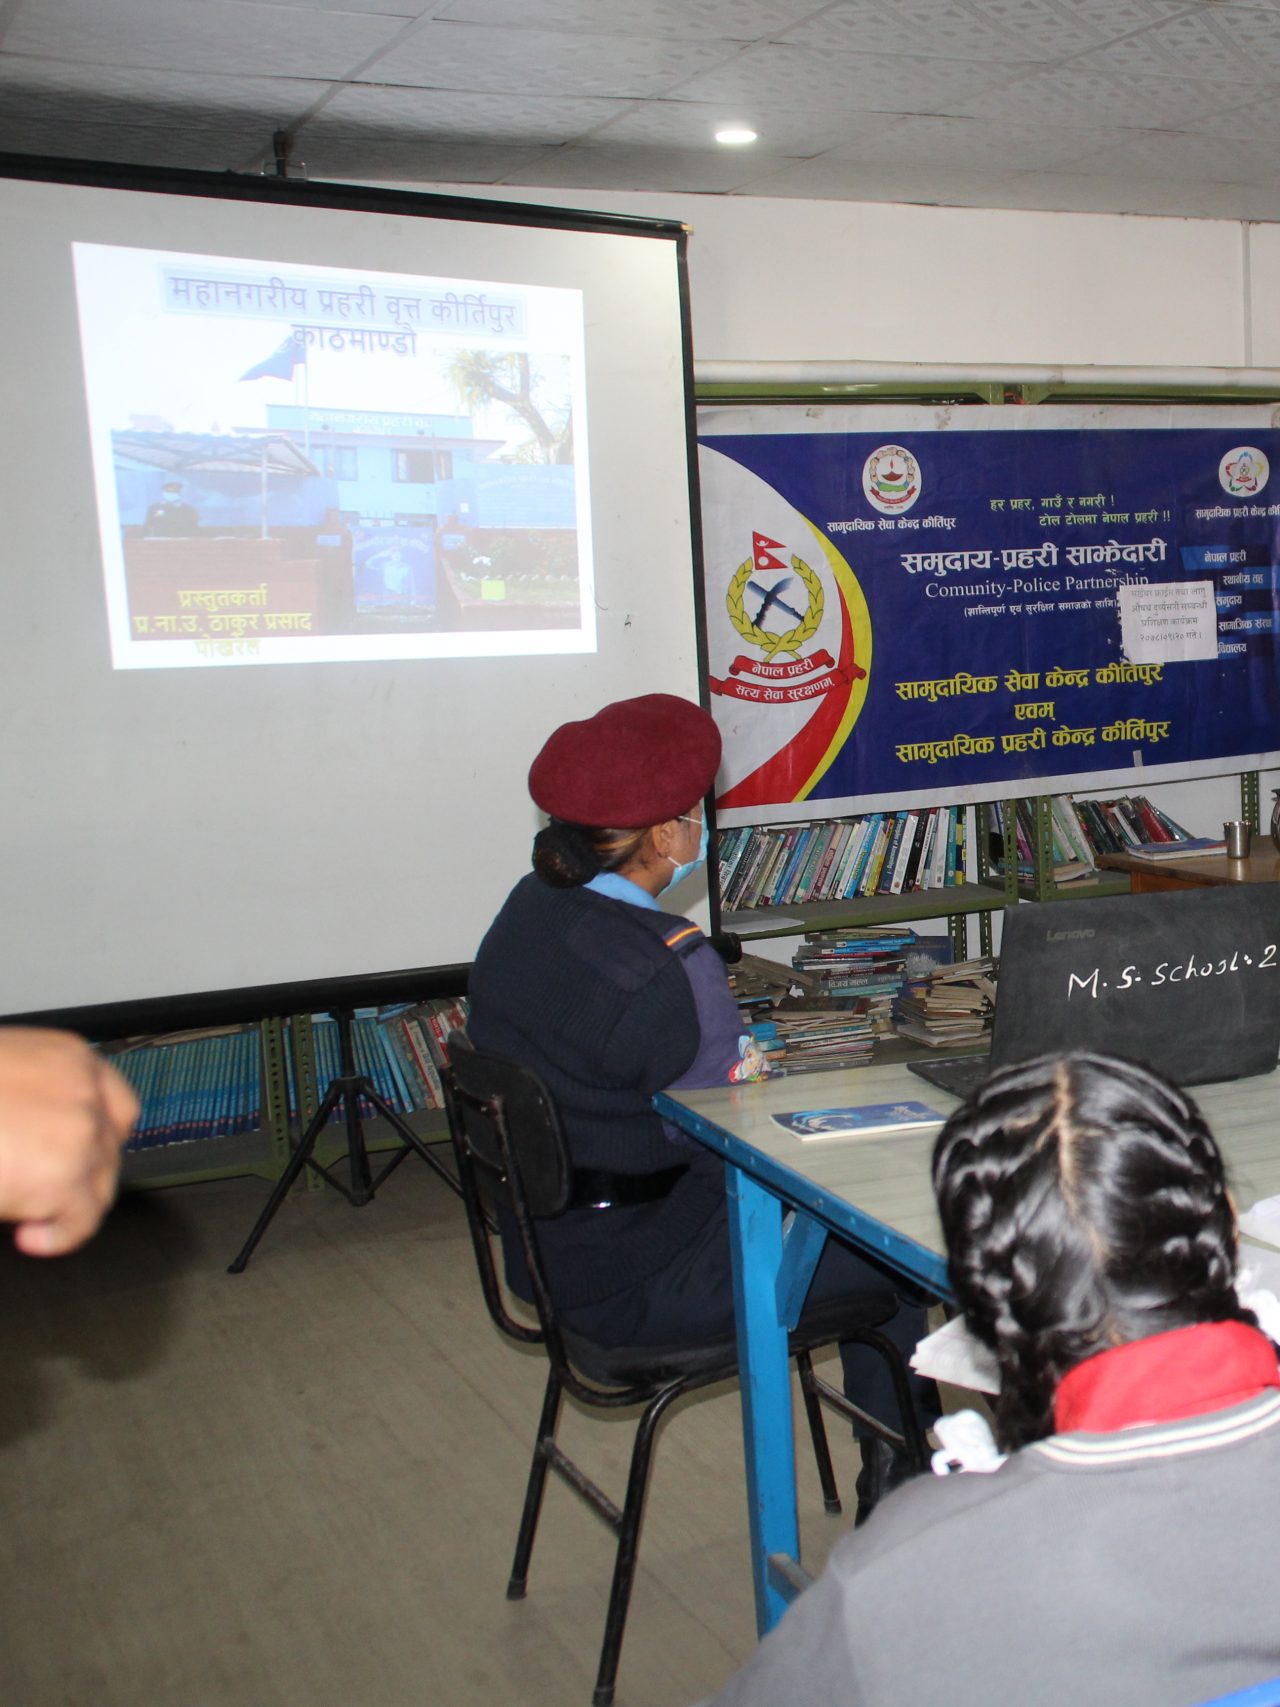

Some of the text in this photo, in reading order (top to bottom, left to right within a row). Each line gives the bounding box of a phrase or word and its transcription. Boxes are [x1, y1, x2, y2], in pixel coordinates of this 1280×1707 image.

[168, 276, 516, 333] महानगरीय प्रहरी वृत्त कीर्तिपुर
[990, 499, 1005, 512] हर
[1041, 493, 1062, 508] गाउँ
[1067, 498, 1075, 509] र
[1079, 494, 1106, 508] नगरी
[1195, 505, 1231, 520] सामुदायिक
[1233, 504, 1249, 518] प्रहरी
[827, 514, 957, 534] सामुदायिक सेवा केन्द्र कीर्तिपुर
[1039, 512, 1060, 526] टोल
[1065, 512, 1097, 525] टोलमा
[1102, 511, 1129, 524] नेपाल
[1134, 508, 1158, 523] प्रहरी
[1066, 537, 1168, 566] साझेदारी
[1204, 548, 1246, 563] नेपाल प्रहरी
[925, 572, 1149, 600] Comunity-Police Partnership
[176, 583, 268, 612] प्रस्तुतकर्ता
[208, 613, 260, 639] ठाकुर
[264, 612, 313, 632] प्रसाद
[752, 658, 815, 677] नेपाल प्रहरी
[735, 683, 760, 699] सत्य
[764, 687, 784, 701] सेवा
[895, 671, 998, 702] सामुदायिक
[1004, 669, 1041, 692] सेवा
[1045, 666, 1090, 688] केन्द्र
[1014, 701, 1056, 721] एवम्
[895, 718, 1172, 764] सामुदायिक प्रहरी केन्द्र कीर्तिपुर
[1046, 928, 1096, 942] Lenovo
